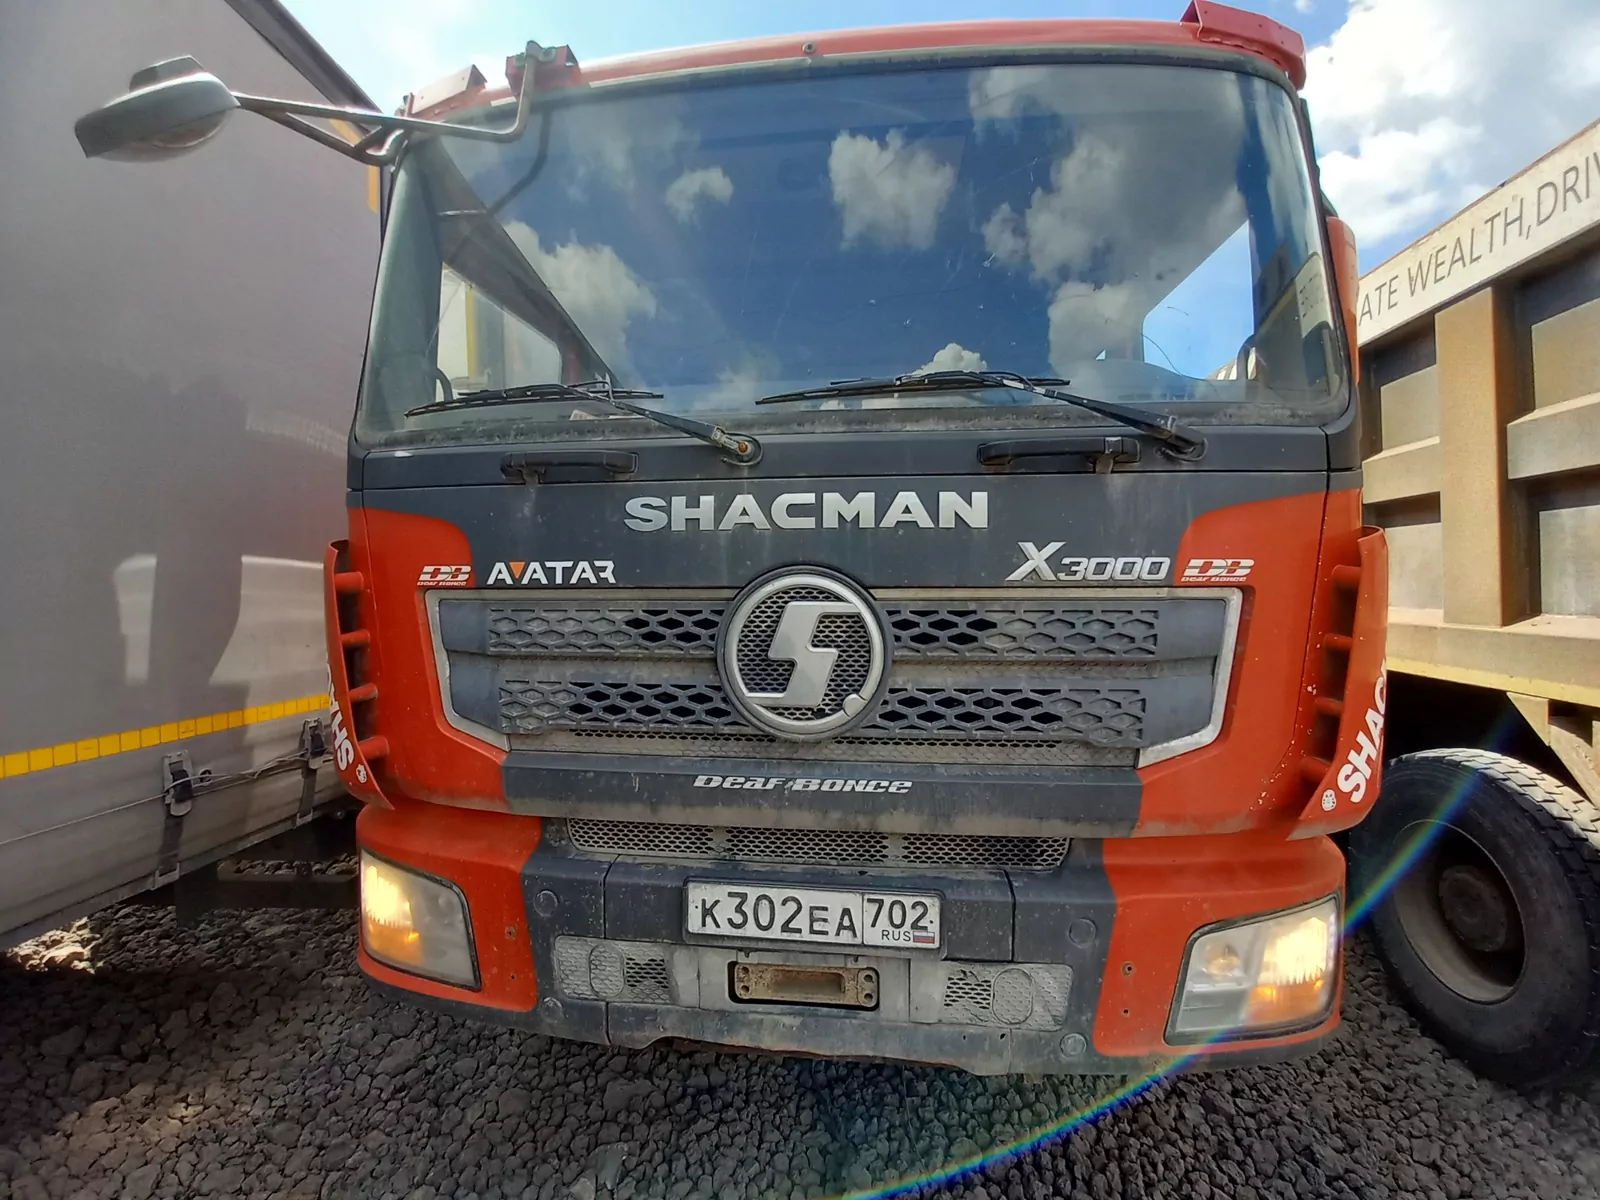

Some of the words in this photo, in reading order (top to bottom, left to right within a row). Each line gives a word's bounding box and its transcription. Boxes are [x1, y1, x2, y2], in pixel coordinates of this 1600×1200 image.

[623, 491, 989, 532] SHACMAN
[486, 560, 617, 585] AVATAR
[1004, 541, 1171, 581] X3000
[1337, 658, 1387, 804] SHAC
[866, 898, 929, 931] 702
[881, 929, 911, 941] RUS
